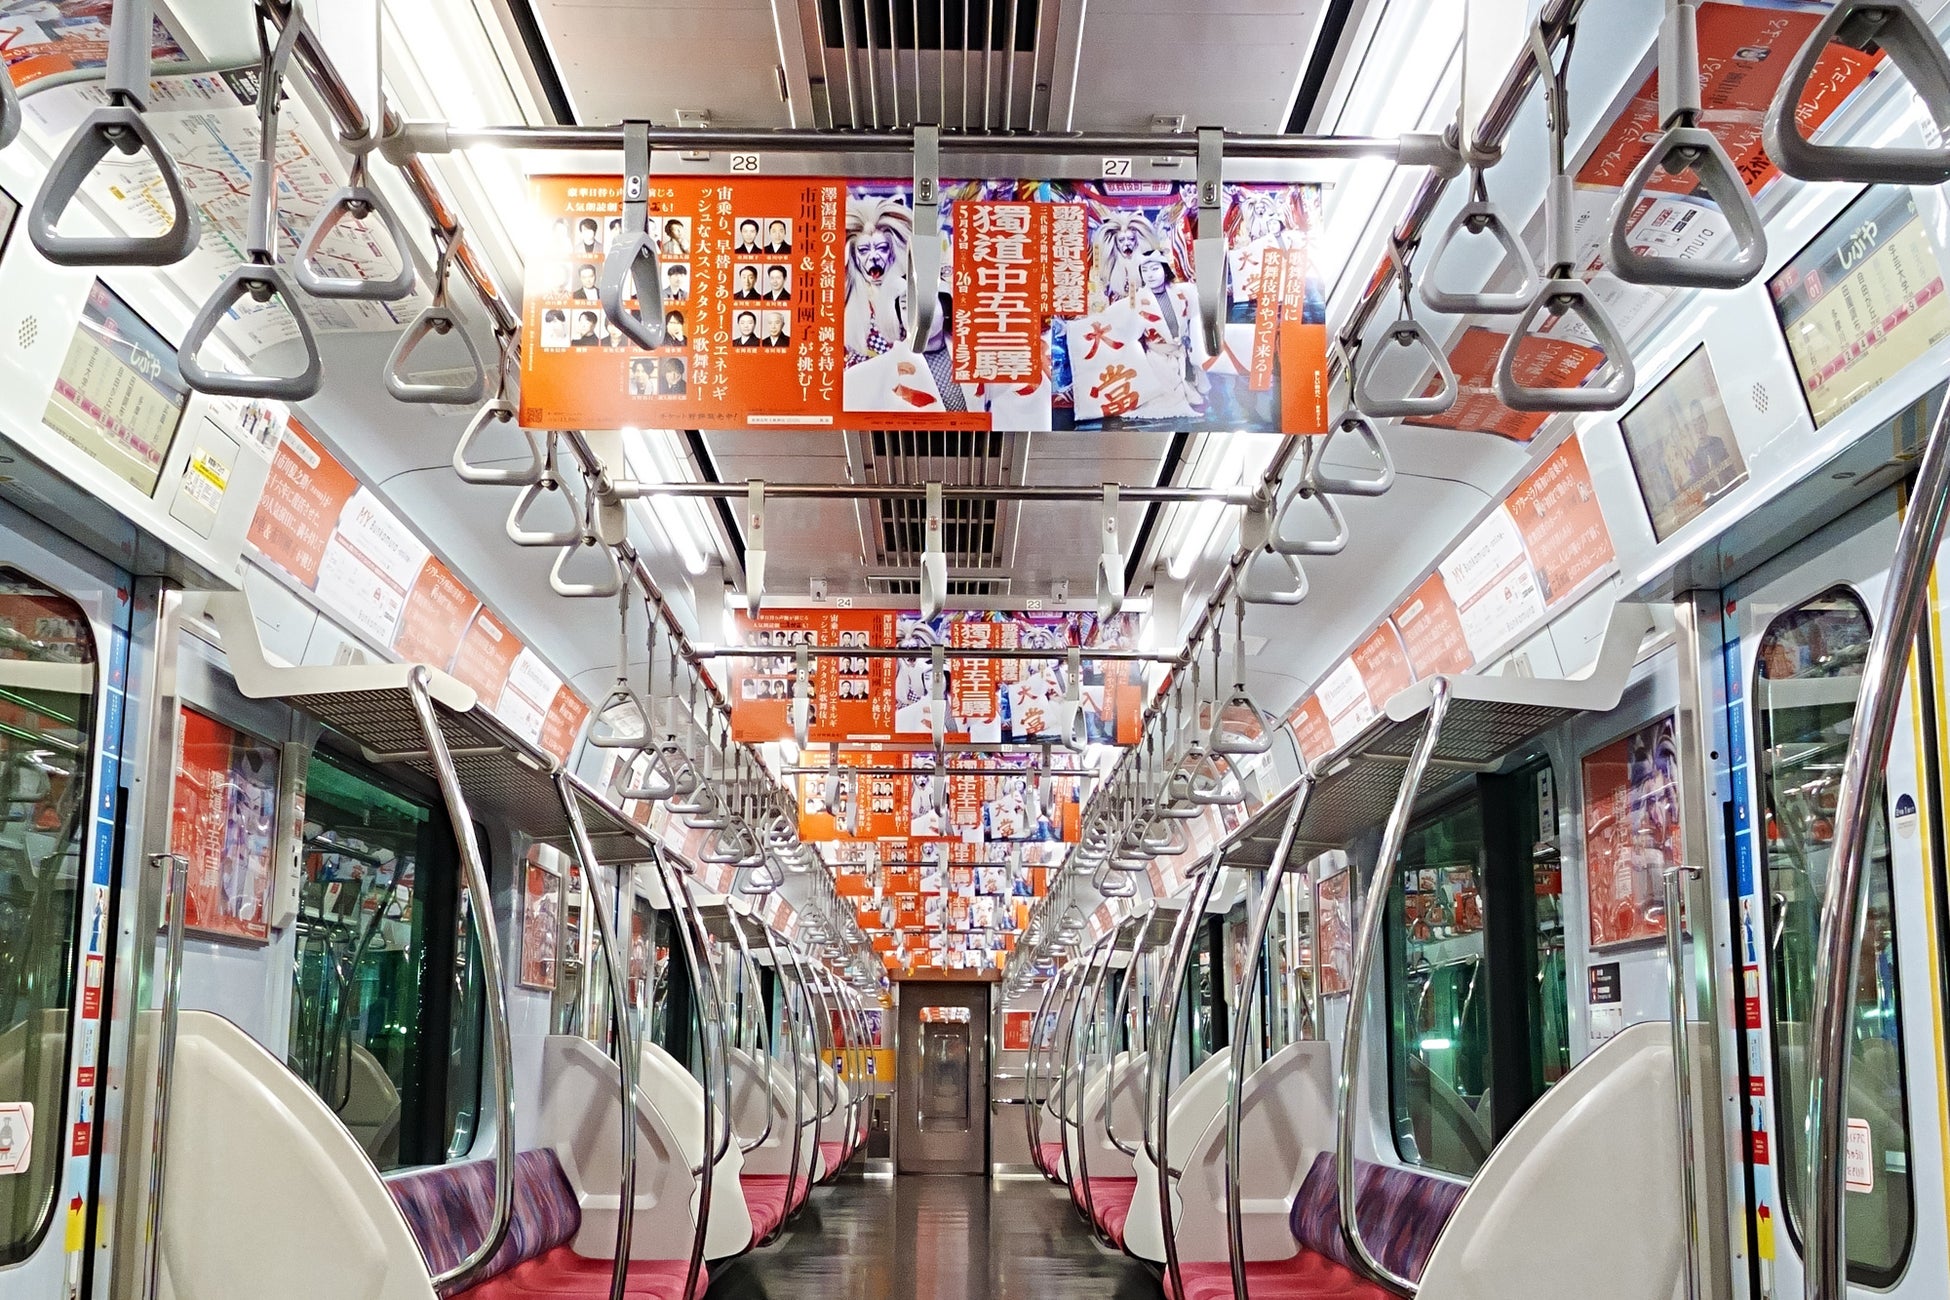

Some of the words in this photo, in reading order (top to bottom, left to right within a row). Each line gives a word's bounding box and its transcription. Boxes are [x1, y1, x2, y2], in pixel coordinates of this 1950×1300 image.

[732, 155, 758, 171] 28
[1104, 160, 1130, 176] 27
[1837, 219, 1878, 270] しぶや
[1284, 251, 1302, 322] 歌舞伎町に
[129, 341, 162, 382] しぶや
[1027, 601, 1041, 609] 23
